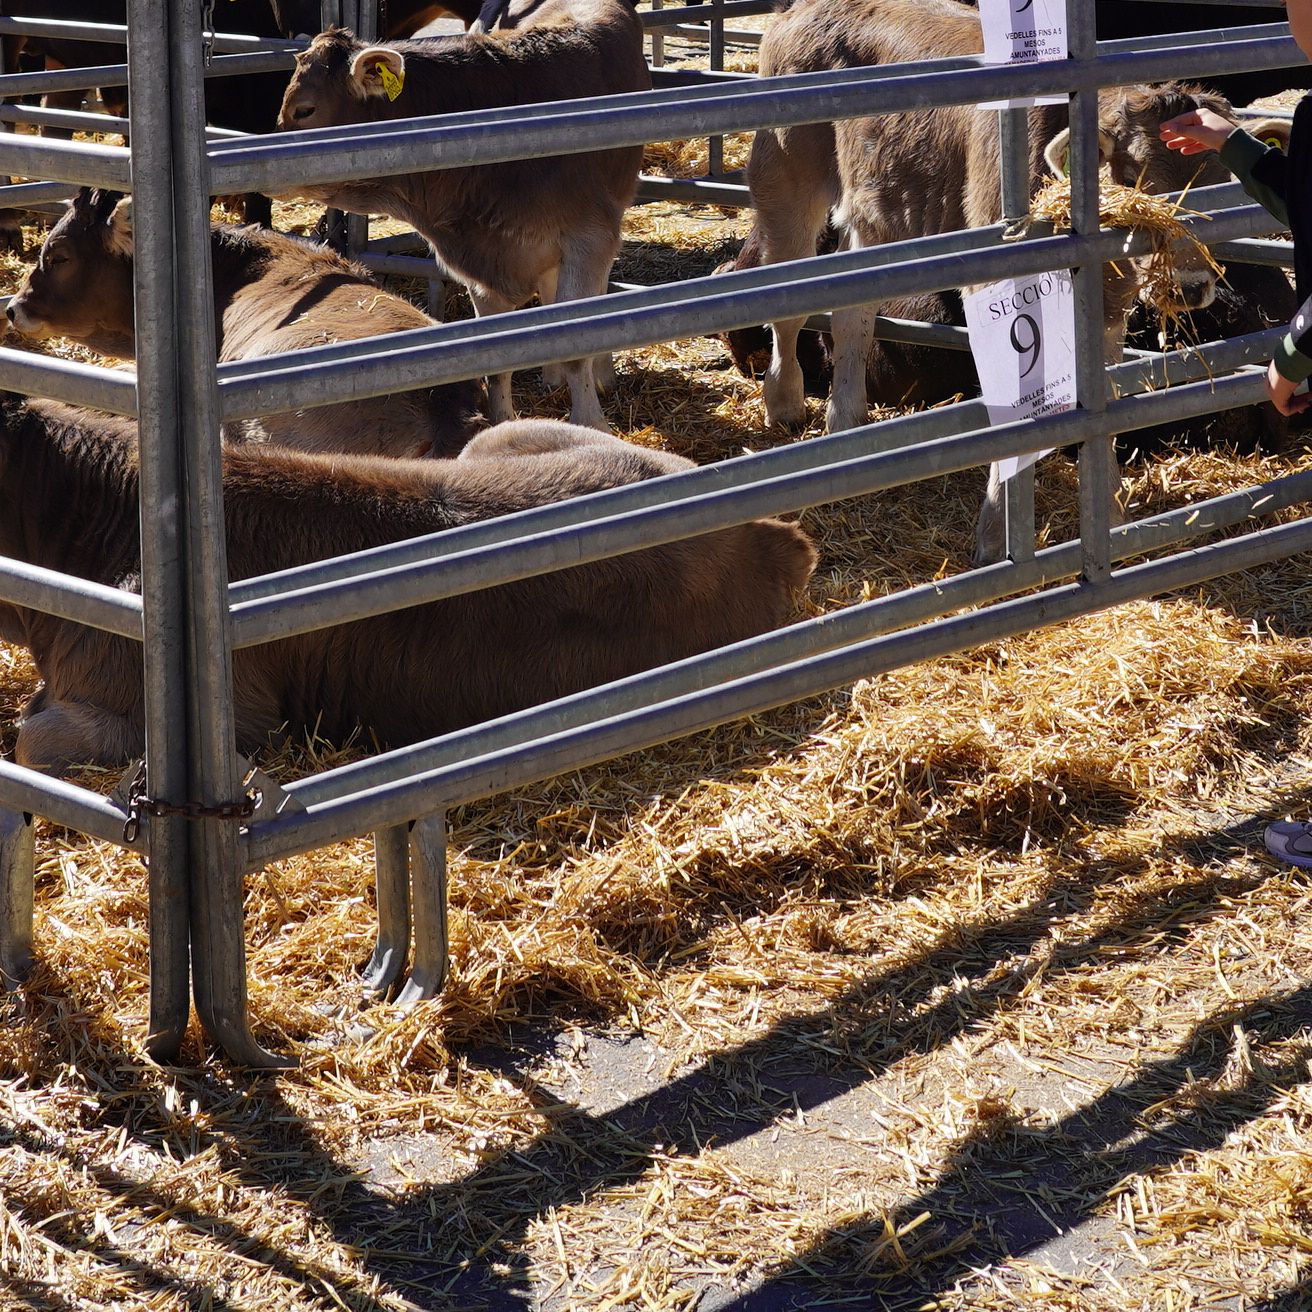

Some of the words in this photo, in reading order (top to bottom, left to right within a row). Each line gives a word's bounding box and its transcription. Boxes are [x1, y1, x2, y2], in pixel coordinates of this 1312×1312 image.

[1004, 29, 1037, 40] VEDELLES
[1038, 28, 1052, 37] FINS
[1024, 38, 1046, 48] MESOS
[1010, 47, 1061, 59] AMUNTANYADES
[988, 272, 1052, 321] SECCIÓ
[1009, 313, 1041, 379] 9
[1011, 387, 1045, 409] VEDELLES
[1045, 379, 1060, 391] FINS
[1032, 391, 1055, 409] MESOS
[1019, 392, 1072, 421] MUNTANYADES
